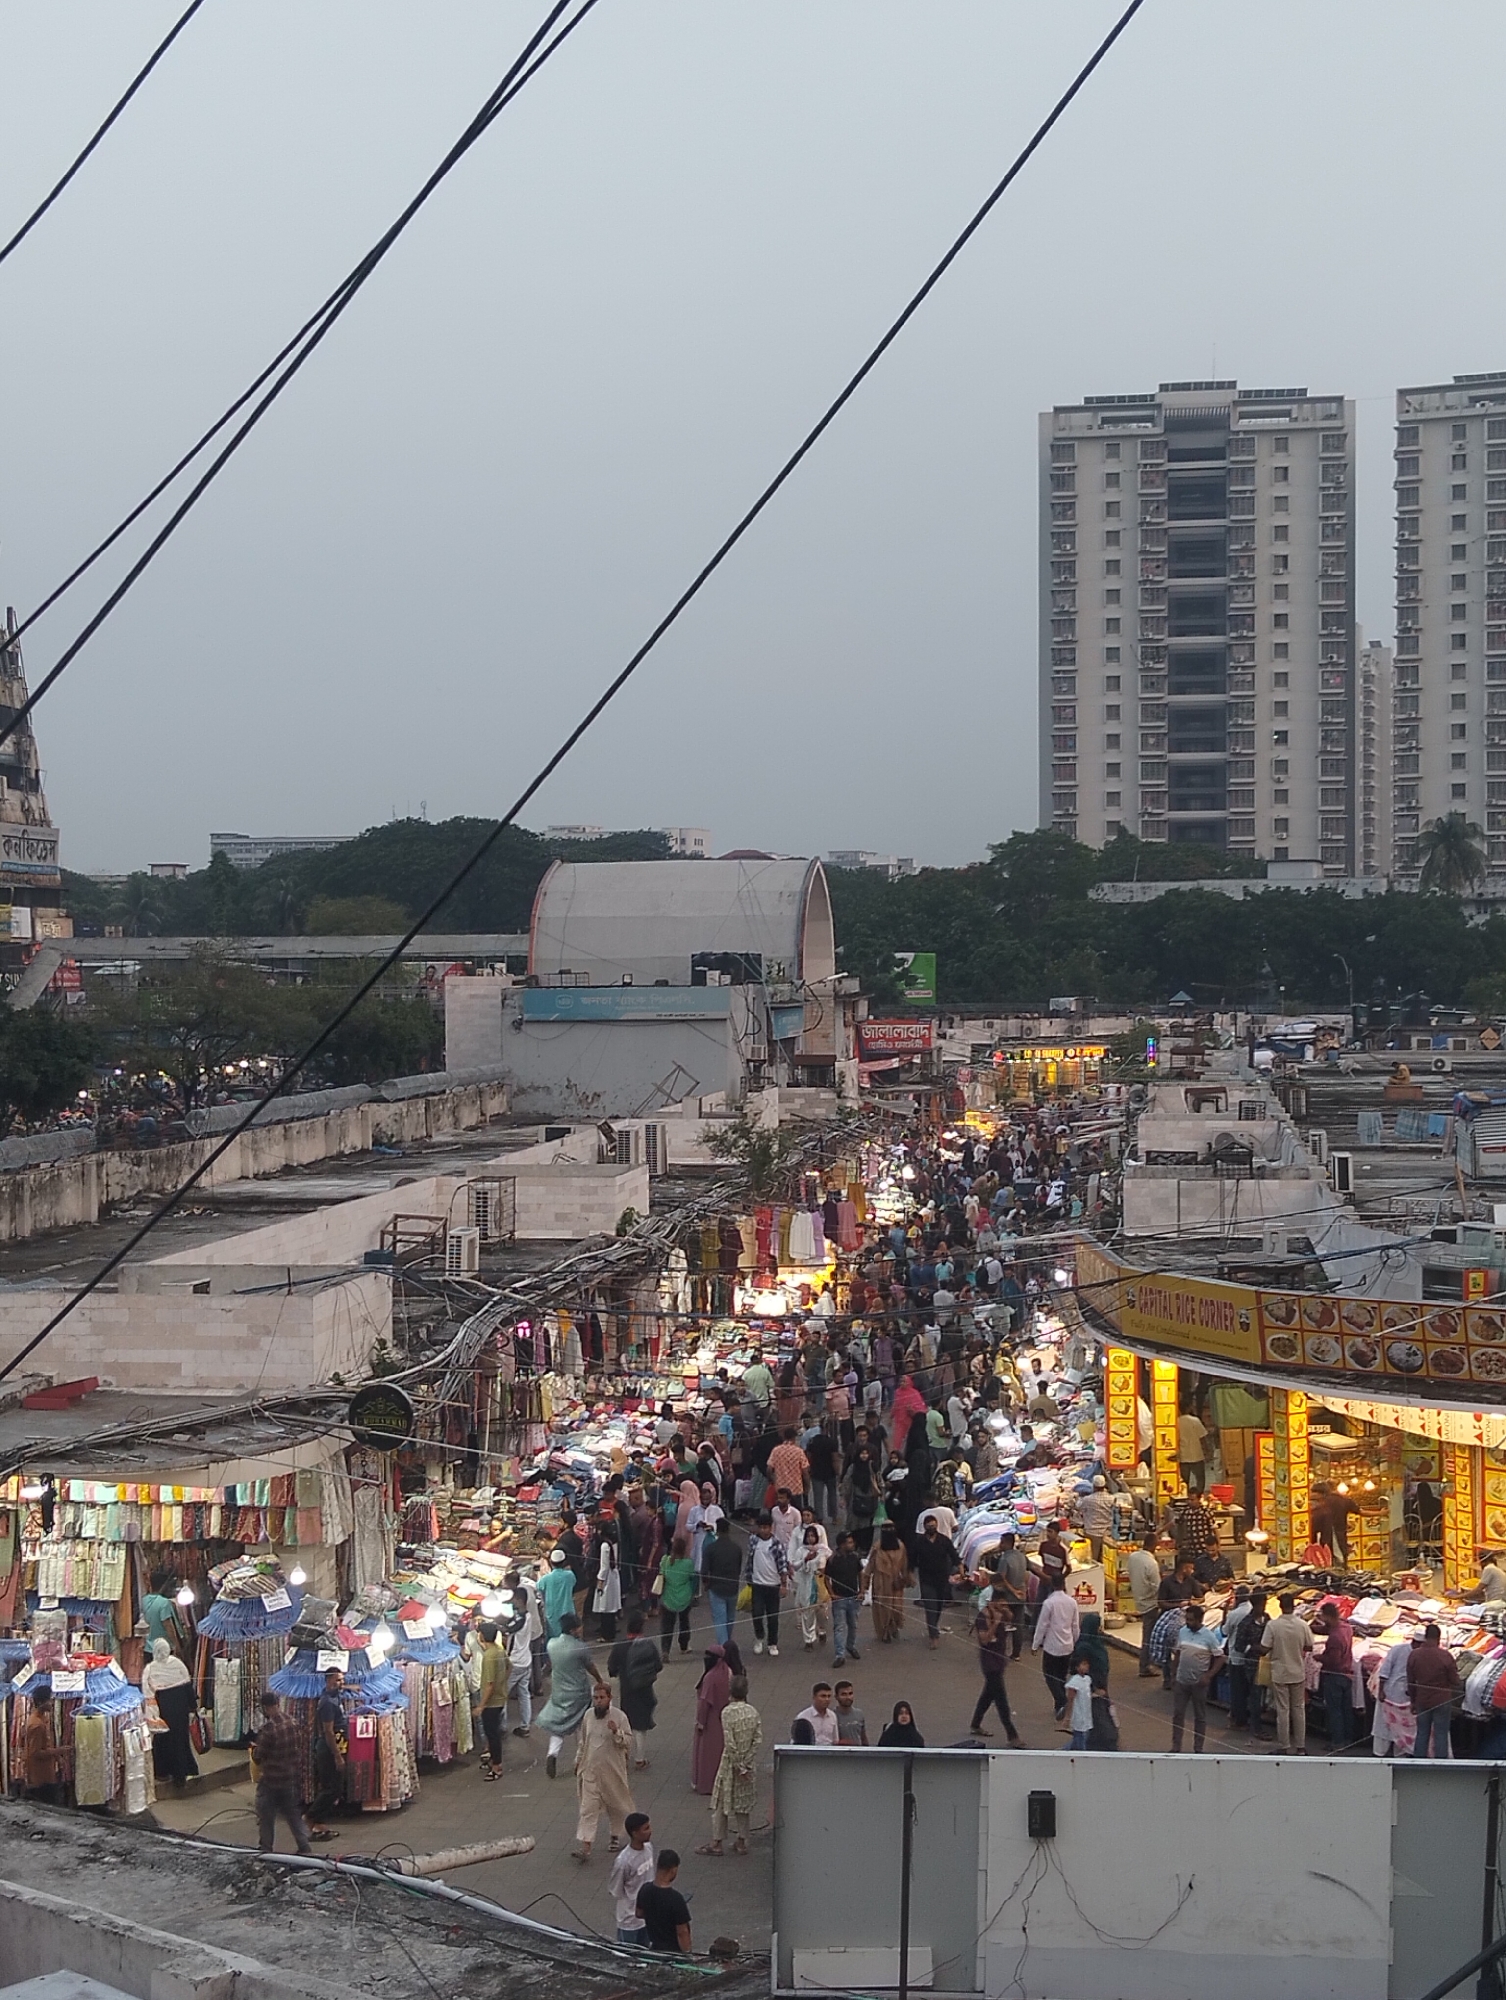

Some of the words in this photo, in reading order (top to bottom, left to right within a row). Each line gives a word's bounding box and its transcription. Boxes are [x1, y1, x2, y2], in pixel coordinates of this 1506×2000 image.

[861, 1024, 930, 1039] জালালাবাদ
[1138, 1285, 1173, 1321] CAPITAL
[1175, 1293, 1196, 1325] RICE
[1199, 1298, 1236, 1335] CORNER
